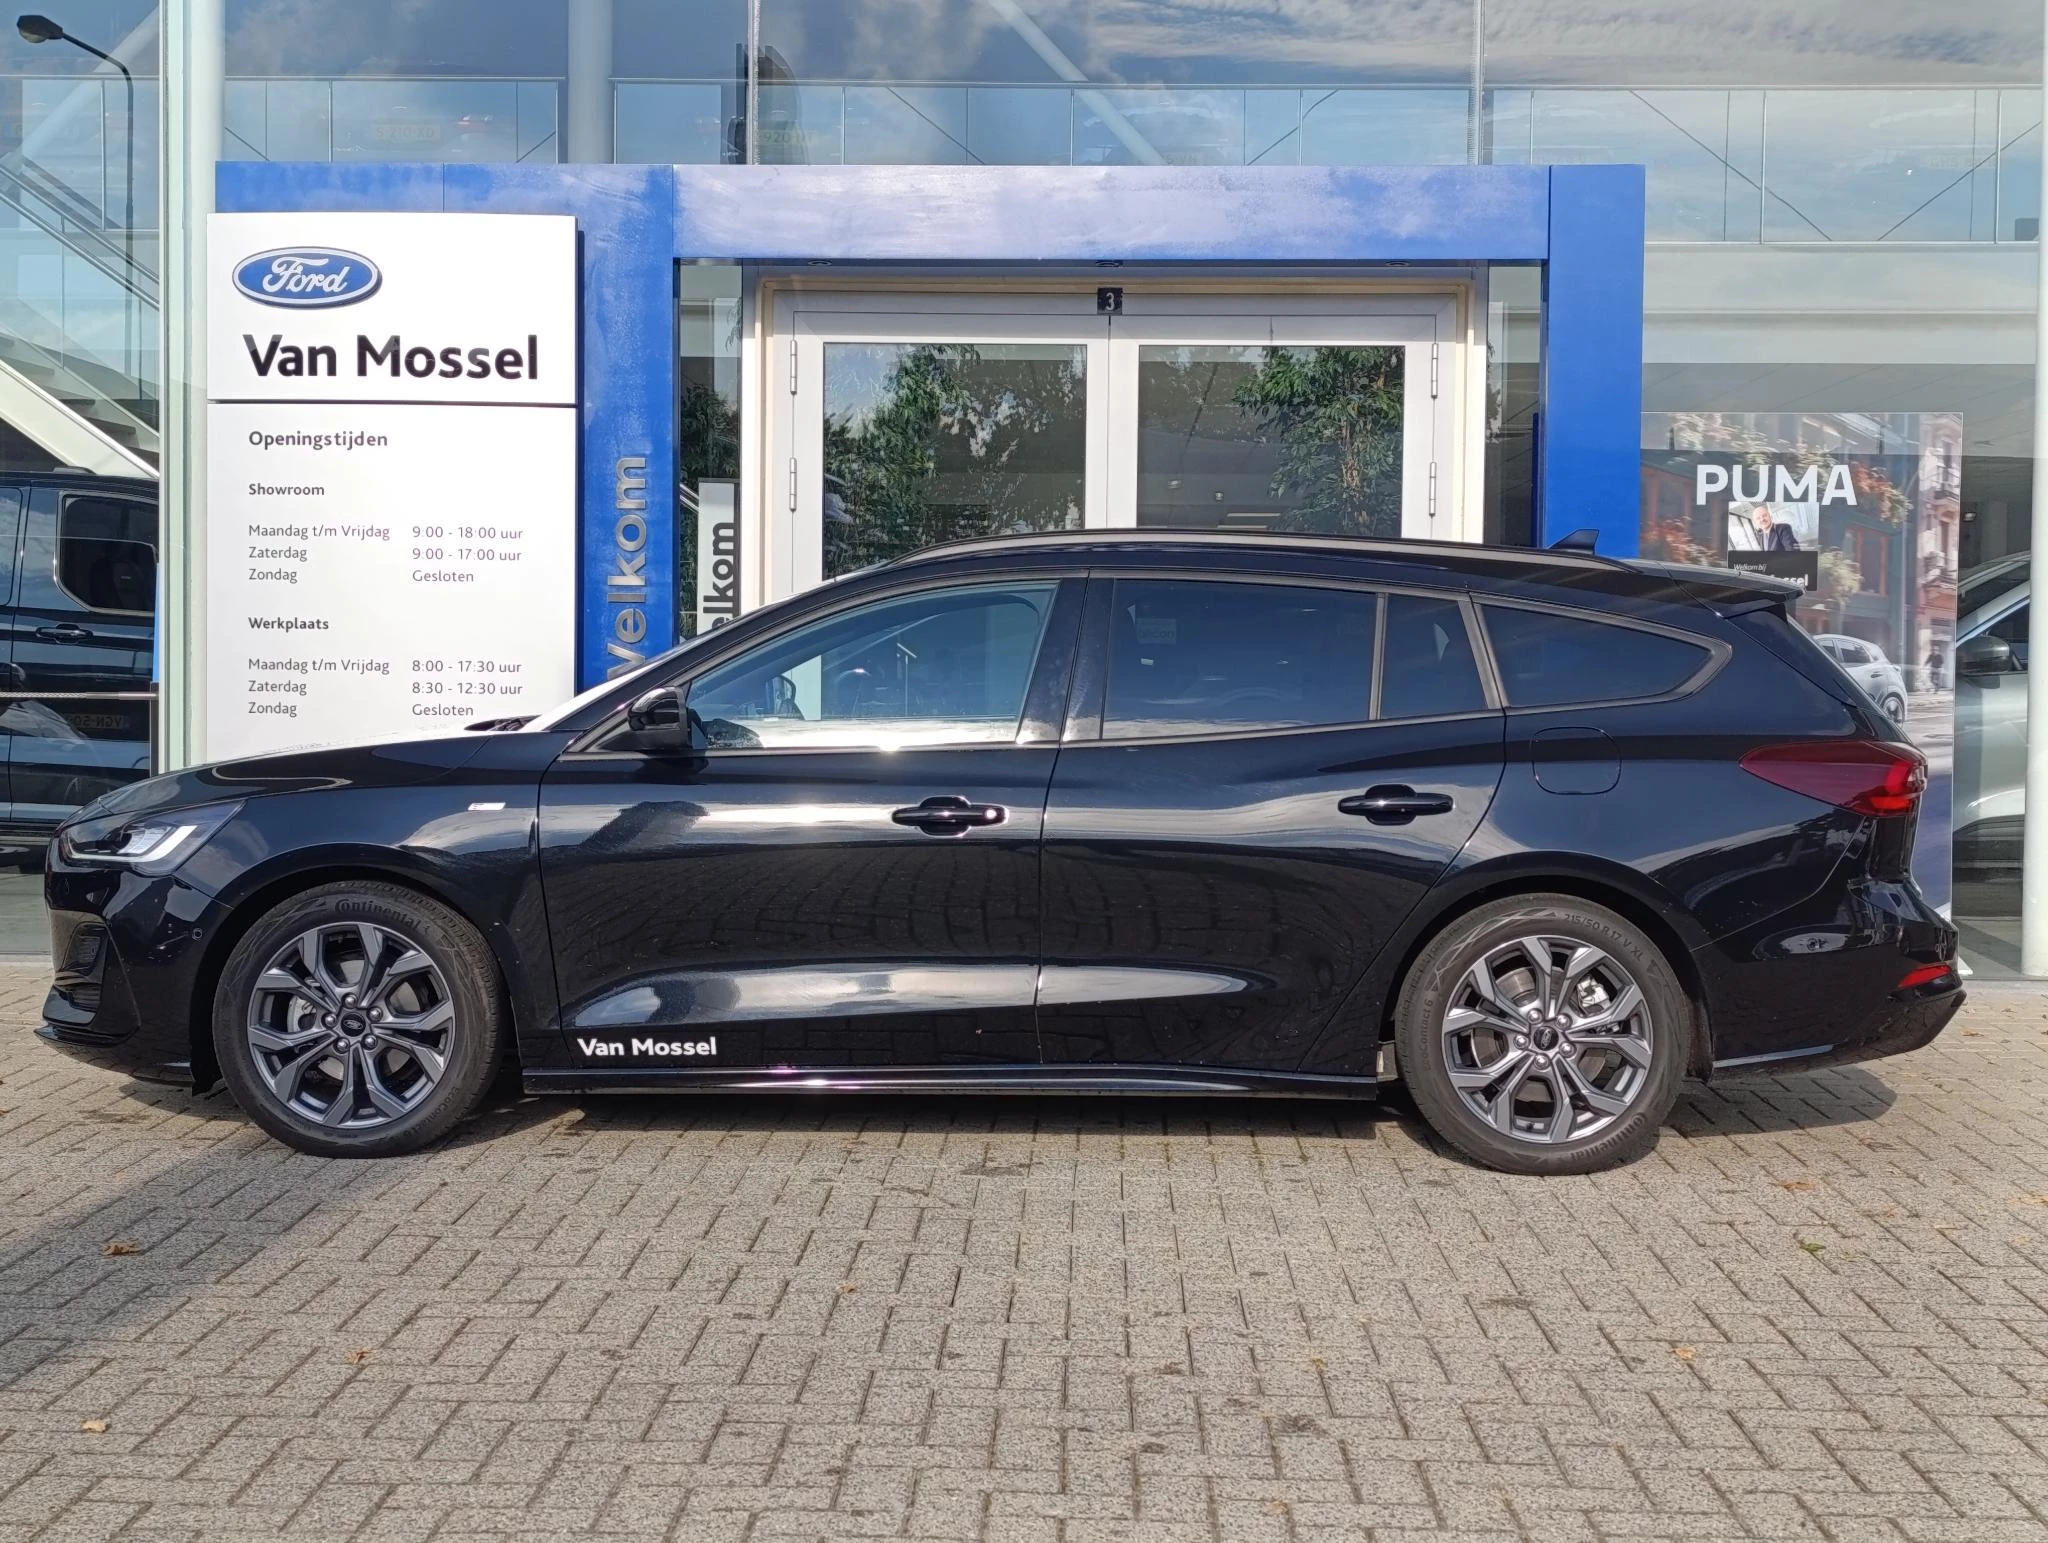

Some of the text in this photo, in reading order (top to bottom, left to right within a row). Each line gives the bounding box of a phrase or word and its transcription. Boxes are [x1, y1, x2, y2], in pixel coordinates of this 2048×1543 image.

[262, 256, 350, 293] Ford
[1106, 292, 1115, 311] 3
[242, 334, 538, 380] Van Mossel
[249, 430, 388, 451] Openingstijden
[248, 483, 325, 496] Showroom
[1696, 464, 1857, 505] PUMA
[248, 524, 309, 541] Maandag
[312, 525, 338, 538] t/m
[341, 525, 390, 542] Vrijdag
[412, 526, 444, 538] 9:00
[458, 526, 497, 539] 18:00
[501, 530, 523, 539] uur
[248, 546, 308, 562] Zaterdag
[412, 548, 444, 560] 9:00
[458, 548, 496, 561] 17:00
[499, 552, 523, 561] uur
[248, 568, 474, 584] Zondag Gesloten
[248, 617, 329, 634] Werkplaats
[248, 658, 309, 674] Maandag
[312, 659, 337, 672] t/m
[341, 659, 390, 675] Vrijdag
[412, 660, 444, 672] 8:00
[457, 660, 495, 673] 17:30
[499, 664, 522, 673] uur
[248, 680, 307, 696] Zaterdag
[412, 682, 444, 694] 8:30
[457, 682, 496, 695] 12:30
[500, 686, 523, 695] uur
[248, 701, 474, 718] Zondag Gesloten
[335, 898, 421, 931] Continental
[1564, 913, 1600, 929] 215/50
[1631, 946, 1644, 961] XL
[577, 1036, 717, 1056] Van Mossel
[1571, 1112, 1647, 1160] Continental
